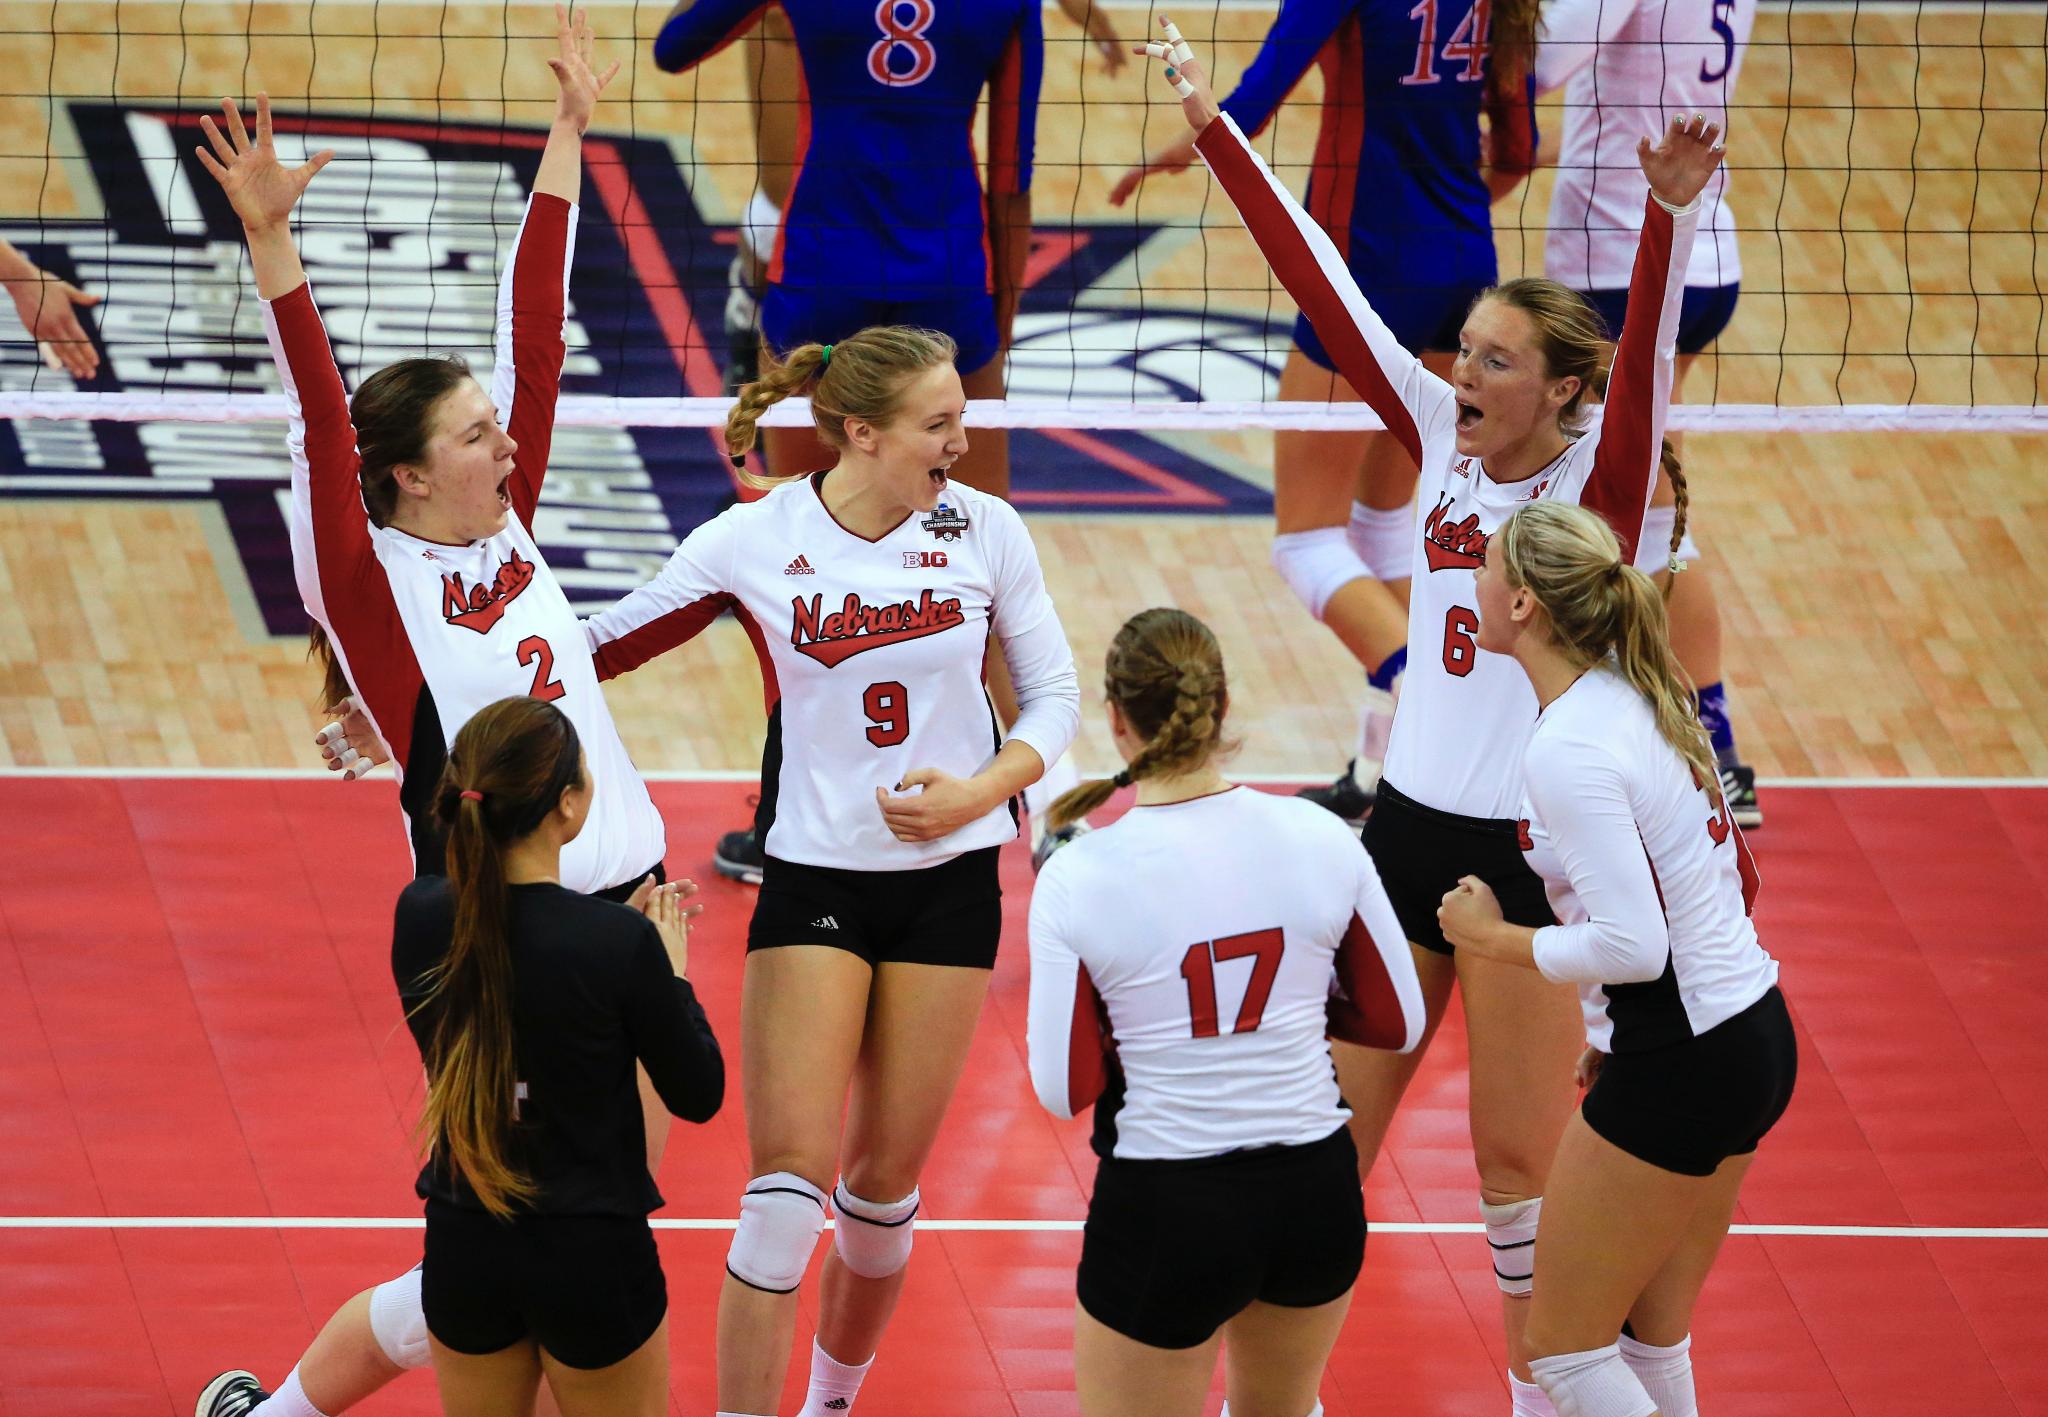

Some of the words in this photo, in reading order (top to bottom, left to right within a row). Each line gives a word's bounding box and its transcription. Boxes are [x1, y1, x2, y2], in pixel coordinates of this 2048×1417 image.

[867, 0, 936, 87] 8
[1397, 0, 1491, 85] 14
[1699, 0, 1735, 83] 5
[926, 521, 967, 529] CHAMPIONSHIP
[784, 566, 815, 575] adidas
[791, 589, 964, 645] Nebraska
[1442, 605, 1480, 677] 6
[516, 635, 566, 702] 2
[863, 681, 909, 748] 9
[1180, 926, 1285, 1038] 17
